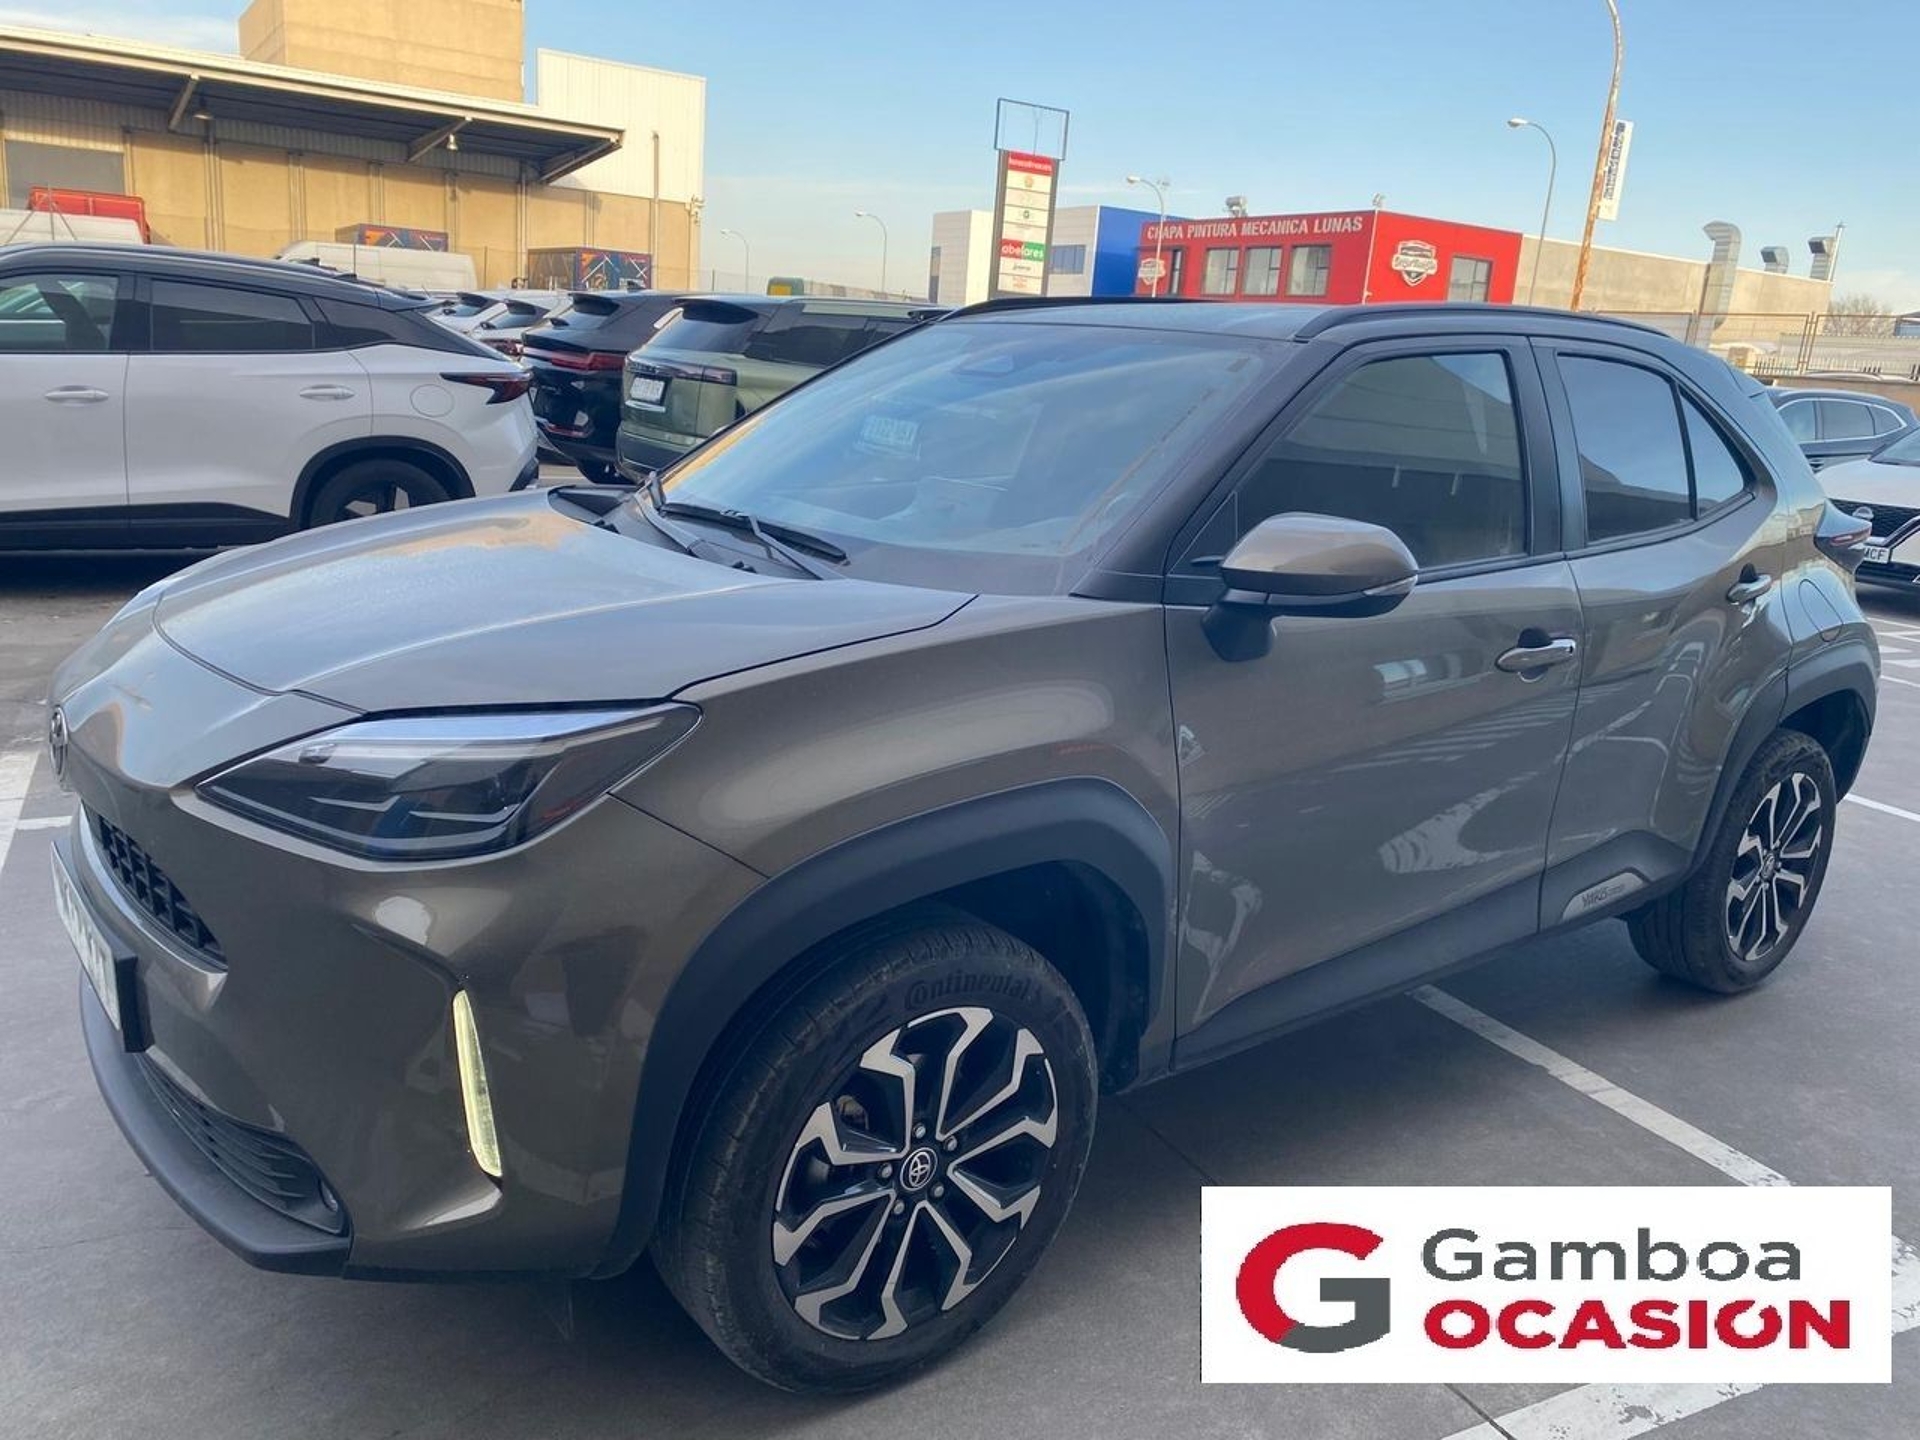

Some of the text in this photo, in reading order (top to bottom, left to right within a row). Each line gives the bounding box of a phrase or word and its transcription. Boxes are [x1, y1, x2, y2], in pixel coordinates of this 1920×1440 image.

[1147, 216, 1363, 240] CHAPA PINTURA MECANICA LUNAS
